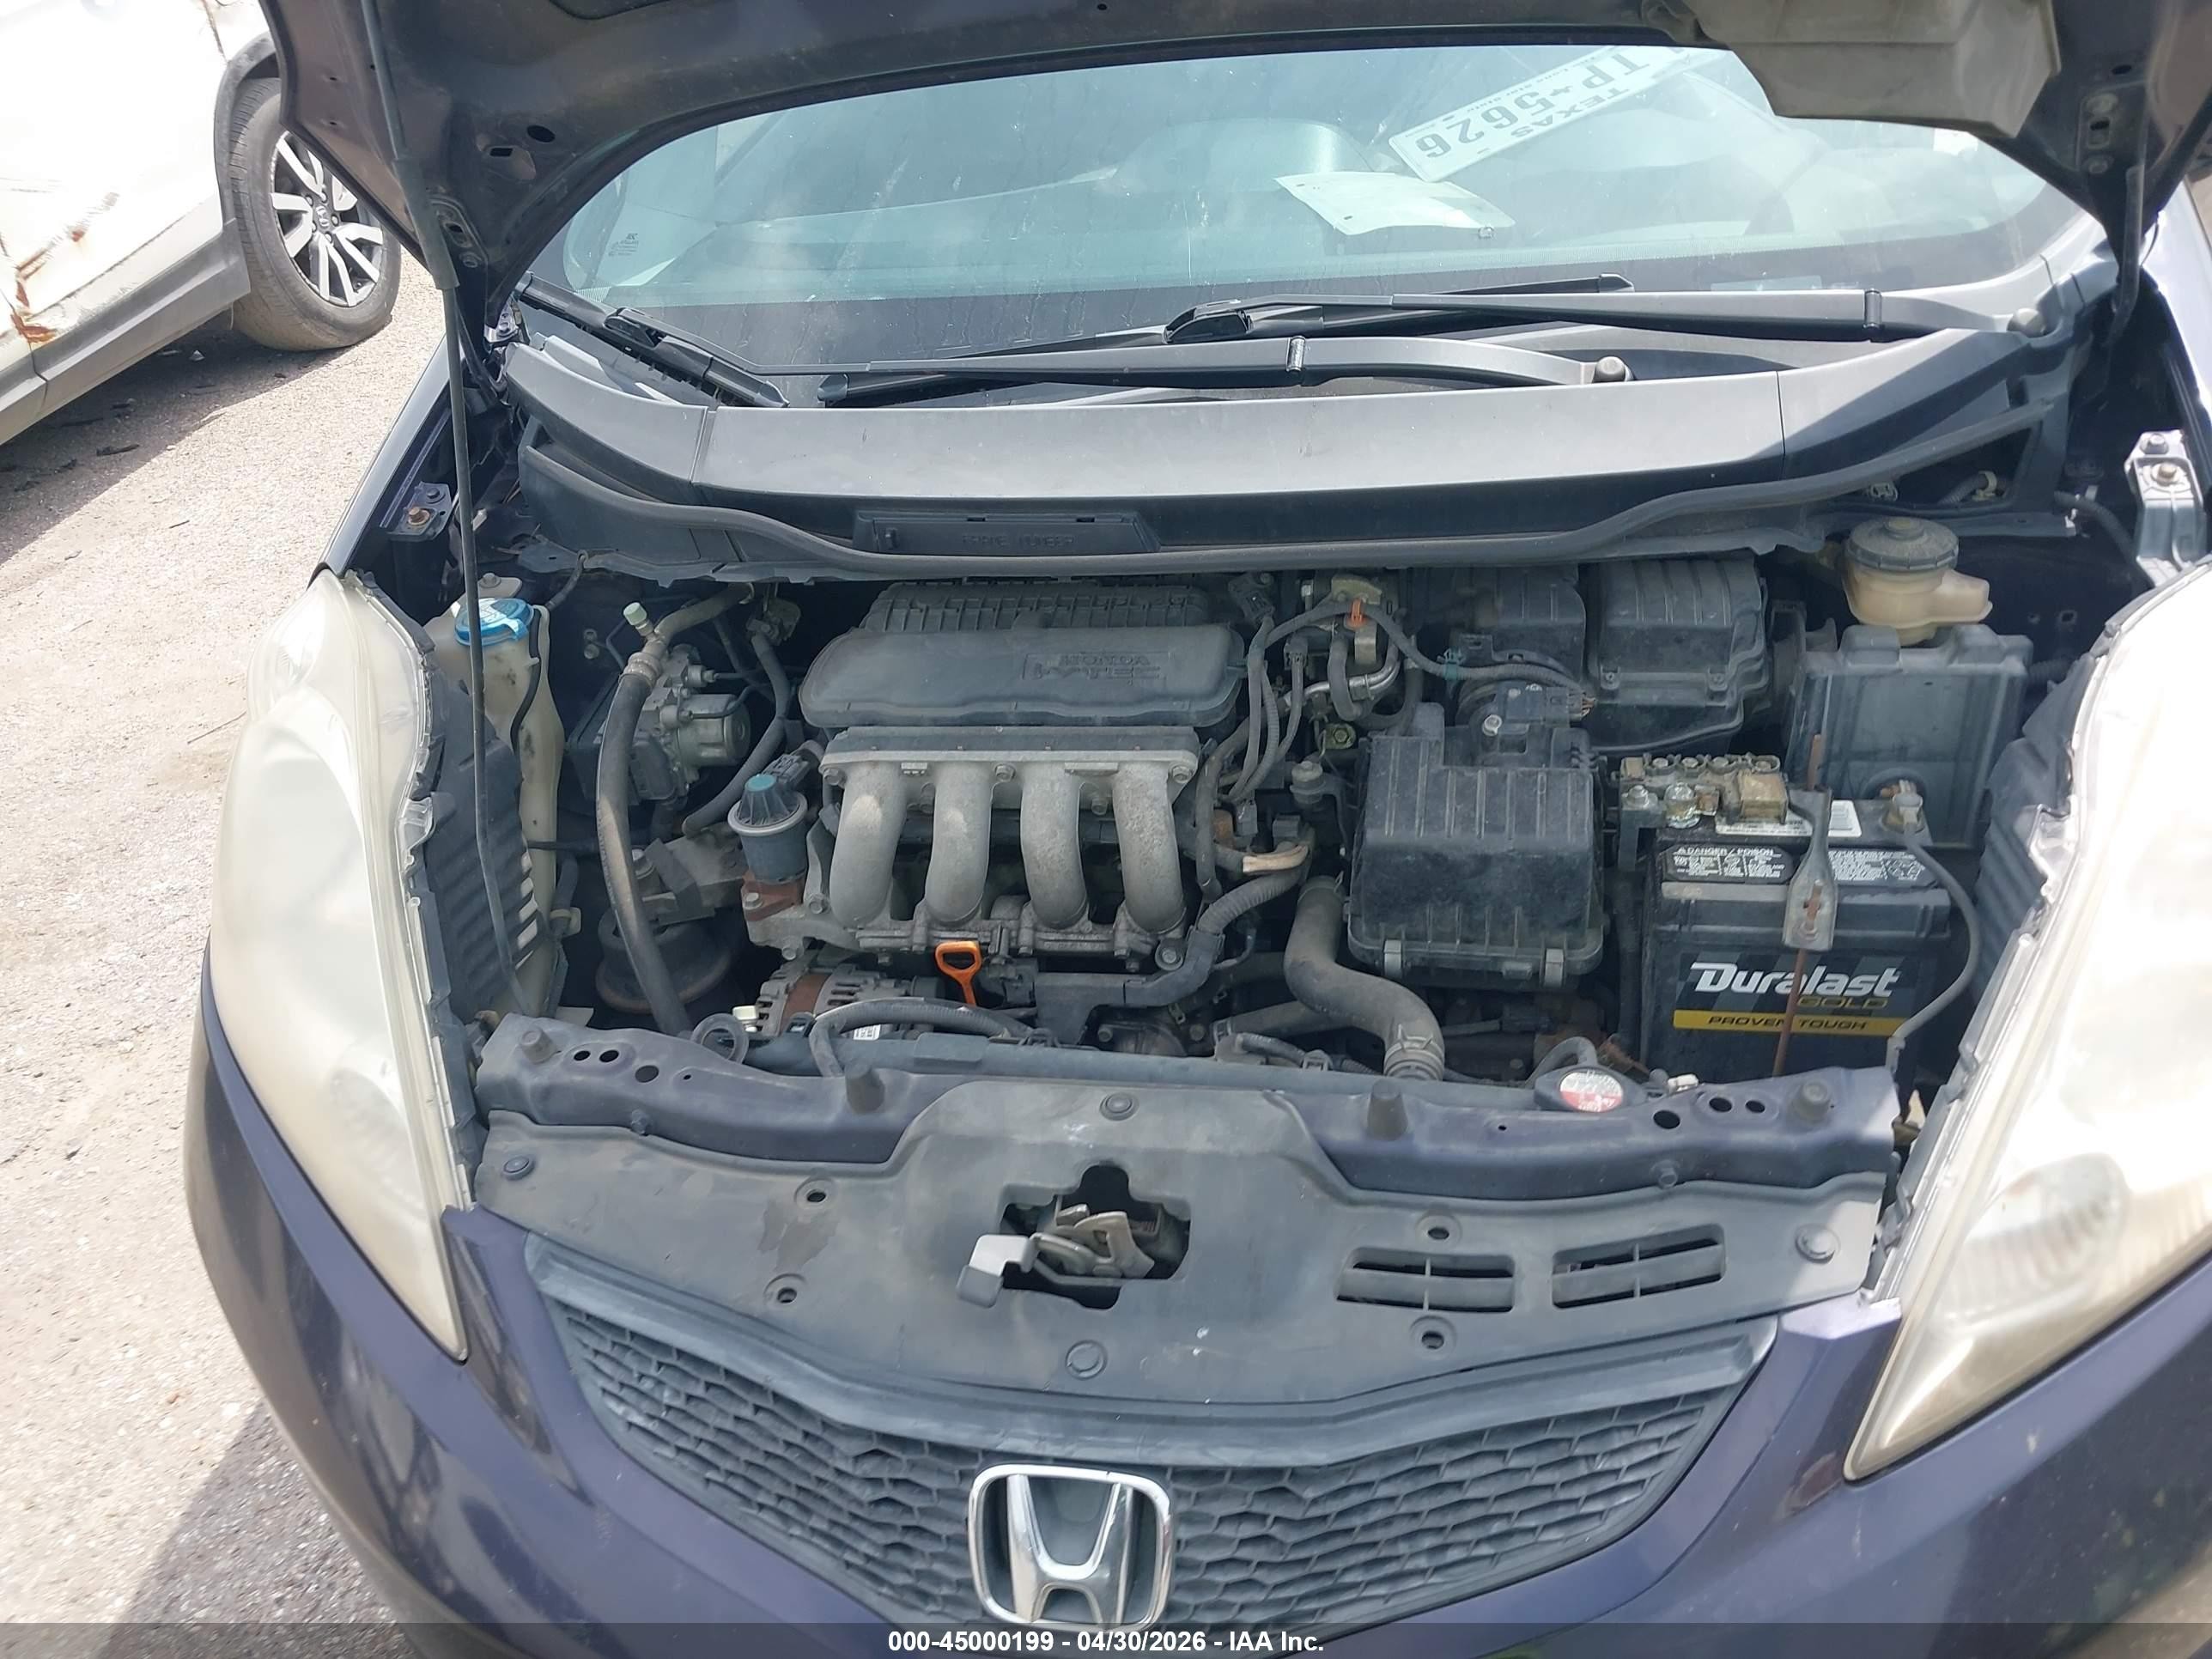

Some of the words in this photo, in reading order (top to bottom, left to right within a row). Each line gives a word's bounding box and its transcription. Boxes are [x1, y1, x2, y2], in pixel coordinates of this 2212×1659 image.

[1511, 88, 1630, 137] TEXAS
[1690, 962, 1902, 997] Duralast
[1796, 994, 1888, 1009] GOLD
[1799, 1018, 1868, 1030] TOUGH
